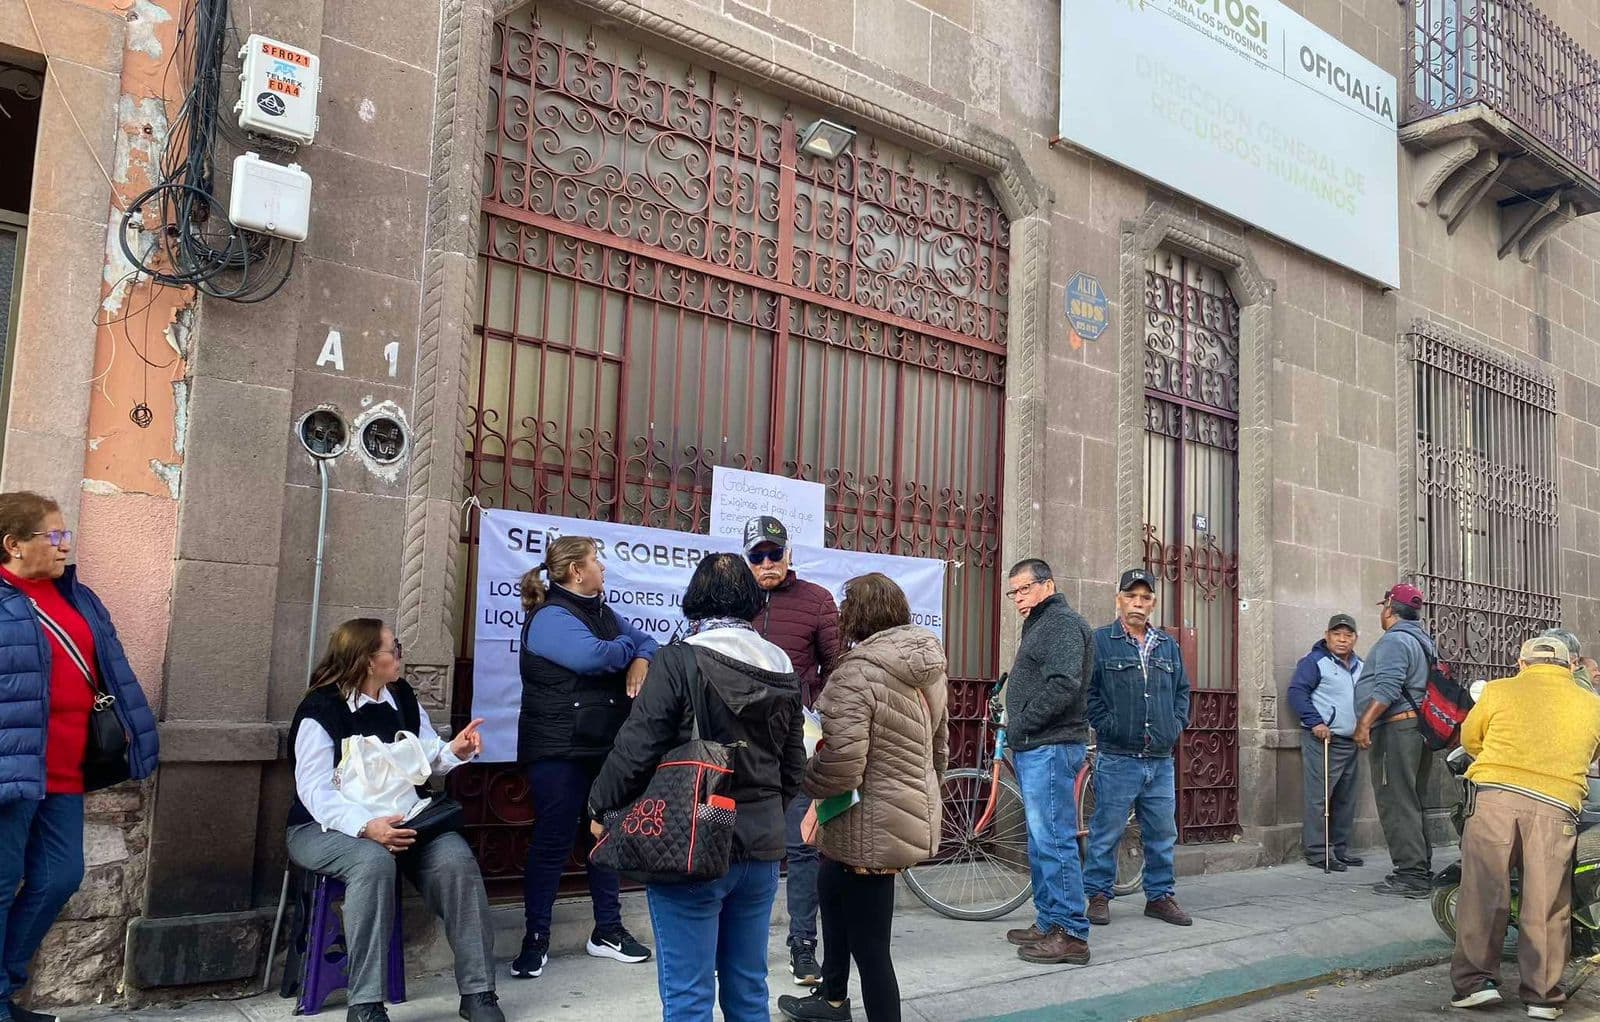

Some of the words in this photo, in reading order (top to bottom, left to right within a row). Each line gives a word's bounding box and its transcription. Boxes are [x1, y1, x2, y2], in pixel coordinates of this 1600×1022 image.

[1196, 7, 1215, 28] LOS
[1216, 20, 1268, 60] POTOSINOS
[265, 71, 304, 88] TELMEX
[1300, 45, 1394, 123] OFICIALÍA
[1264, 150, 1357, 217] HUMANOS
[1344, 164, 1366, 195] DE
[1078, 276, 1098, 297] ALTO
[316, 330, 345, 371] A
[383, 341, 400, 378] 1
[507, 526, 608, 560] SEÑR
[490, 581, 523, 598] LOS
[485, 608, 527, 629] LIQU
[924, 613, 942, 627] DE:
